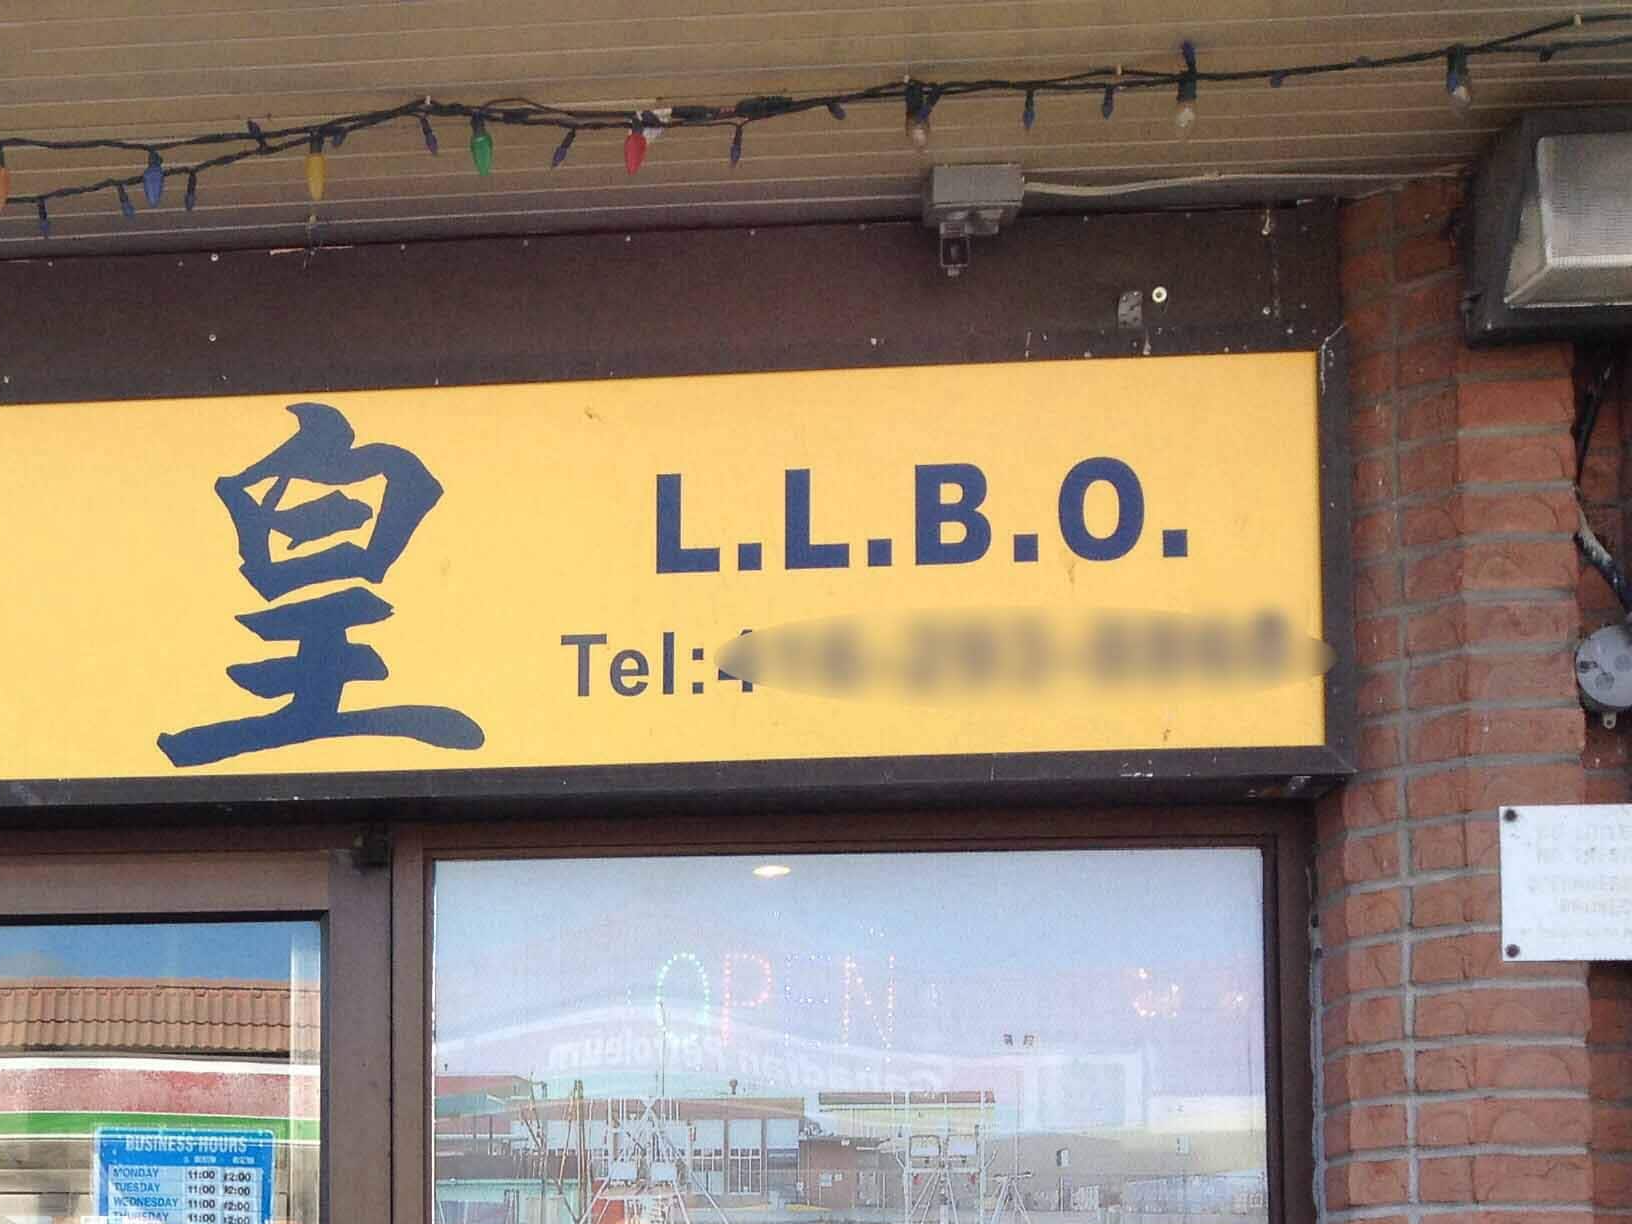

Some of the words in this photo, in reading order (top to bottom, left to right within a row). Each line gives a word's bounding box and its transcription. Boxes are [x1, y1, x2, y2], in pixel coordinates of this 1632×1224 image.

[654, 455, 1191, 575] L.L.B.O.
[125, 1135, 195, 1152] BUSINESS
[197, 1137, 248, 1153] HOURS
[113, 1168, 159, 1178] MONDAY
[187, 1170, 216, 1180] 11:00
[113, 1182, 161, 1192] TUESDAY
[187, 1185, 216, 1195] 11:00
[112, 1197, 179, 1207] WEDNESDAY
[187, 1199, 216, 1209] 11:00
[187, 1214, 216, 1224] 11:00
